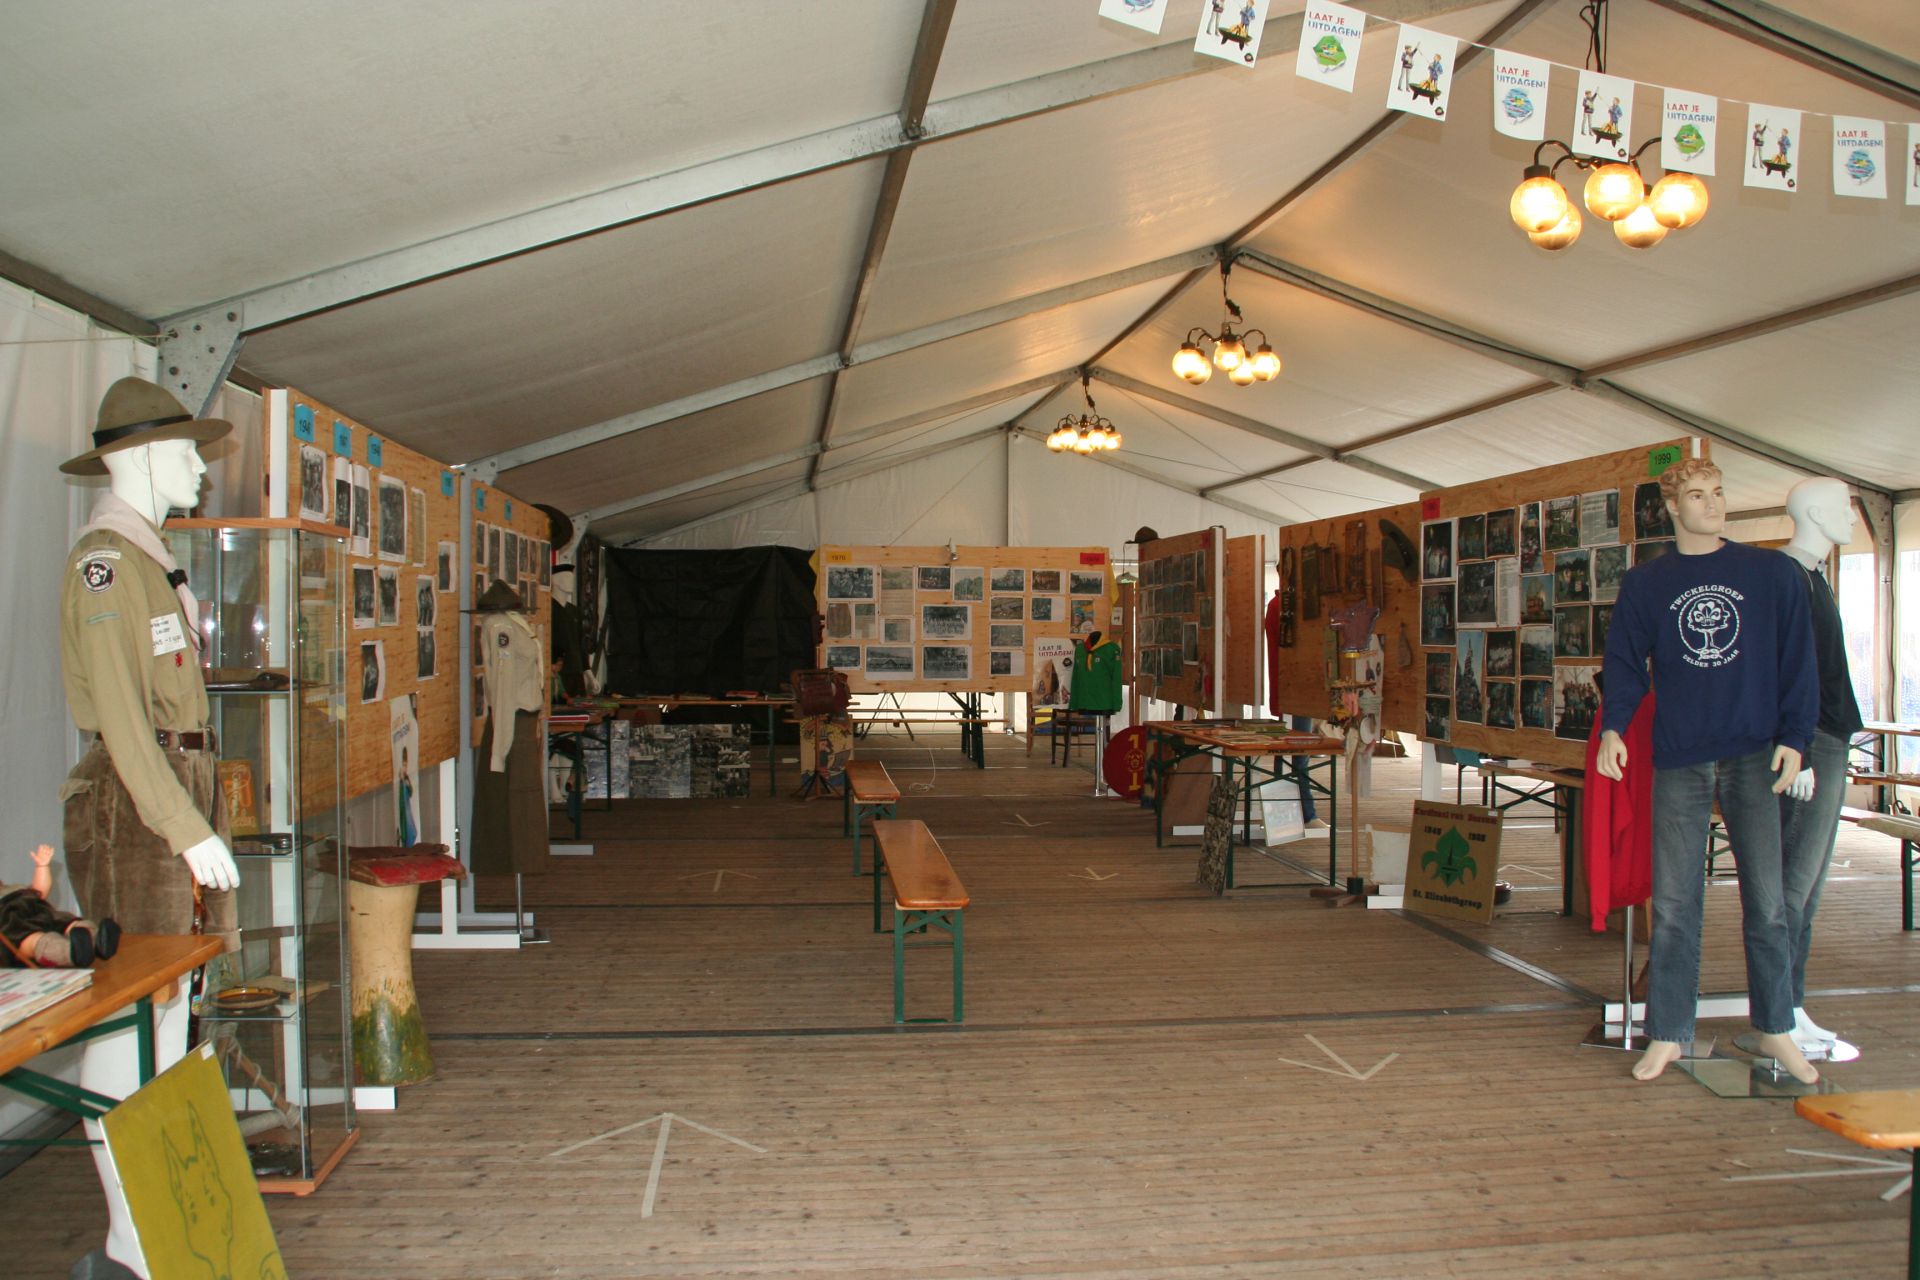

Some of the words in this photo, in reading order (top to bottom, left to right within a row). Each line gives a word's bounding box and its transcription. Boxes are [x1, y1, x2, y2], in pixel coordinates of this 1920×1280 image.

[1309, 11, 1333, 22] LAAT
[1336, 17, 1345, 25] JE
[1496, 65, 1519, 75] LAAT
[1521, 69, 1531, 77] JE
[1496, 74, 1546, 88] UITDAGEN!
[1667, 102, 1688, 111] LAAT
[1667, 112, 1716, 123] UITDAGEN!
[1669, 584, 1744, 612] TWICKELGROEP
[1712, 660, 1722, 668] 30
[1723, 649, 1740, 665] JAAR
